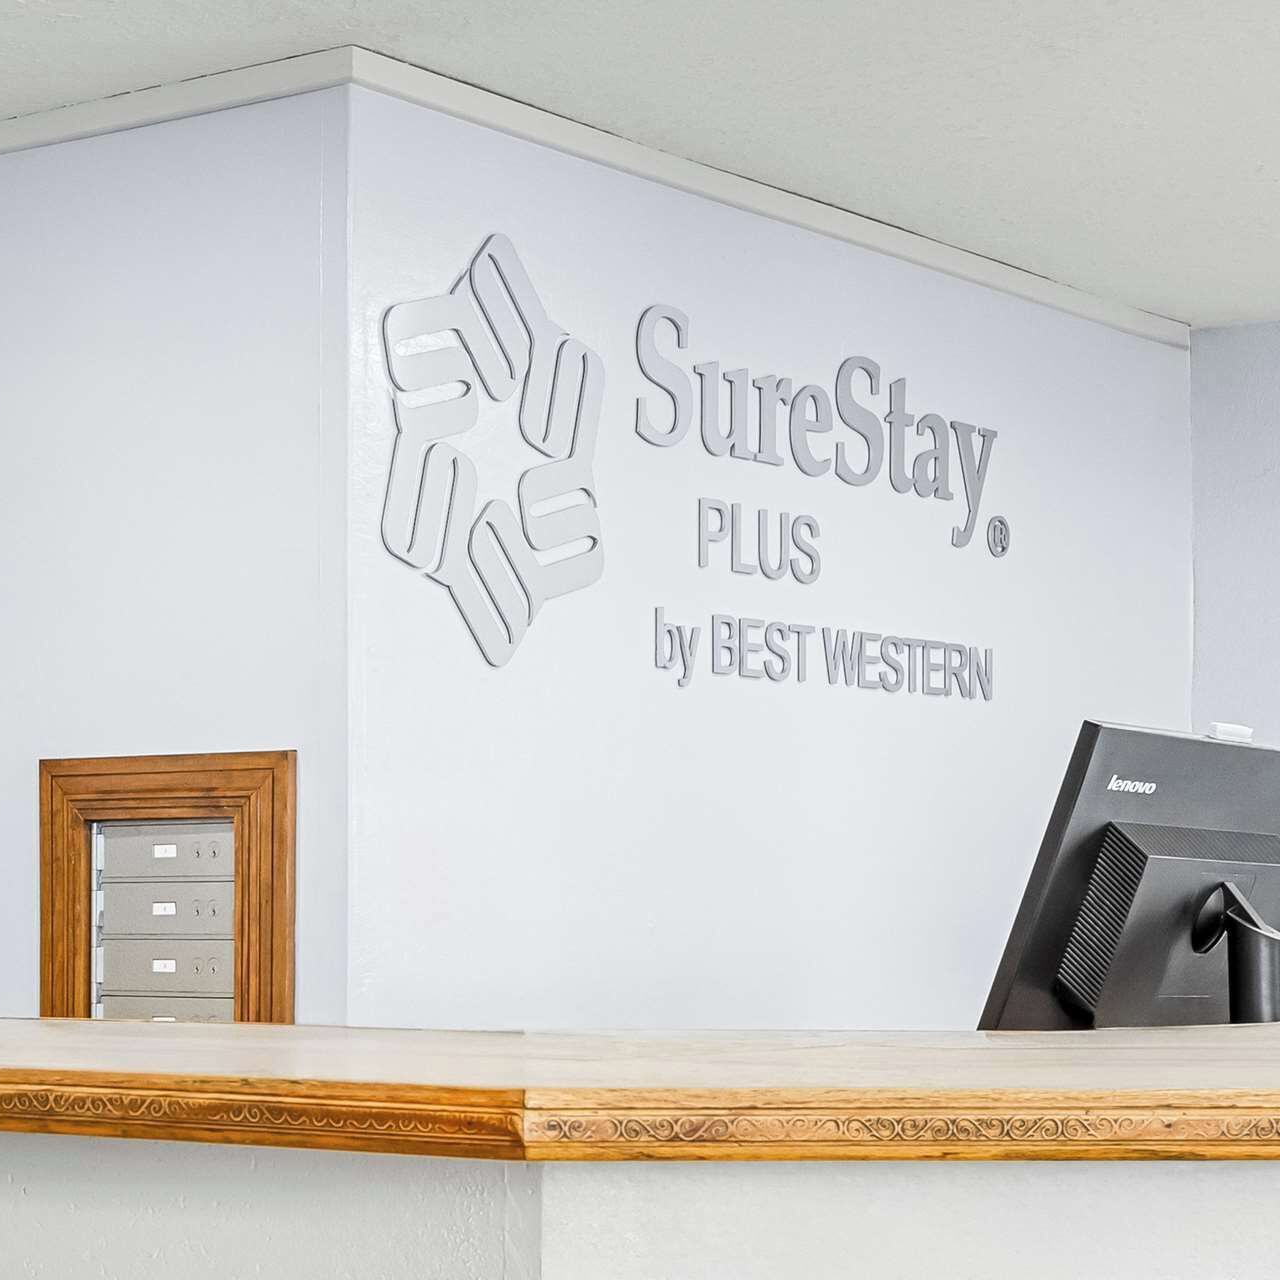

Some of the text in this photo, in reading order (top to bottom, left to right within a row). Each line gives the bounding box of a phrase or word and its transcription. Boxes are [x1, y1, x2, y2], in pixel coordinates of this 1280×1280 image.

[698, 497, 821, 584] PLUS
[654, 607, 993, 701] by BEST WESTERN
[1107, 774, 1157, 795] lenovo
